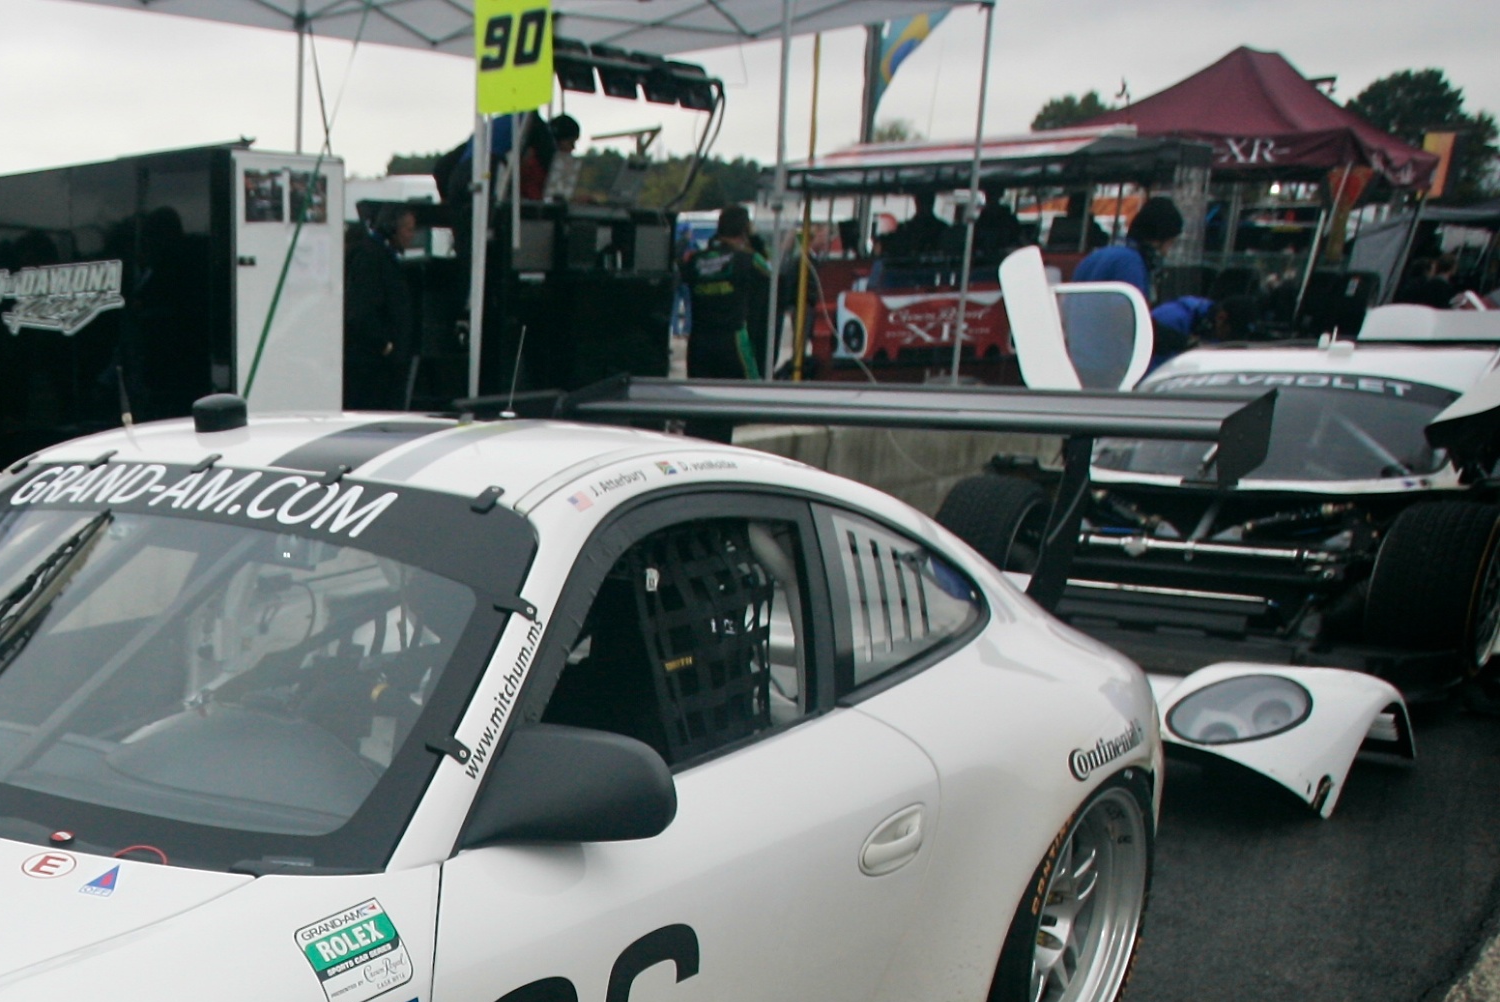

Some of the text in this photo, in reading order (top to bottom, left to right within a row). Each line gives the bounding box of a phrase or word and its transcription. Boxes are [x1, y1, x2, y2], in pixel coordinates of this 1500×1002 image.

[481, 8, 547, 71] 90
[1219, 138, 1275, 163] XR
[1154, 373, 1412, 396] CHEVROLET
[10, 464, 399, 539] GRAND-AM.COM
[600, 469, 648, 494] Atterbury
[464, 619, 544, 781] www.mitchum.ms
[315, 920, 385, 963] ROLEX
